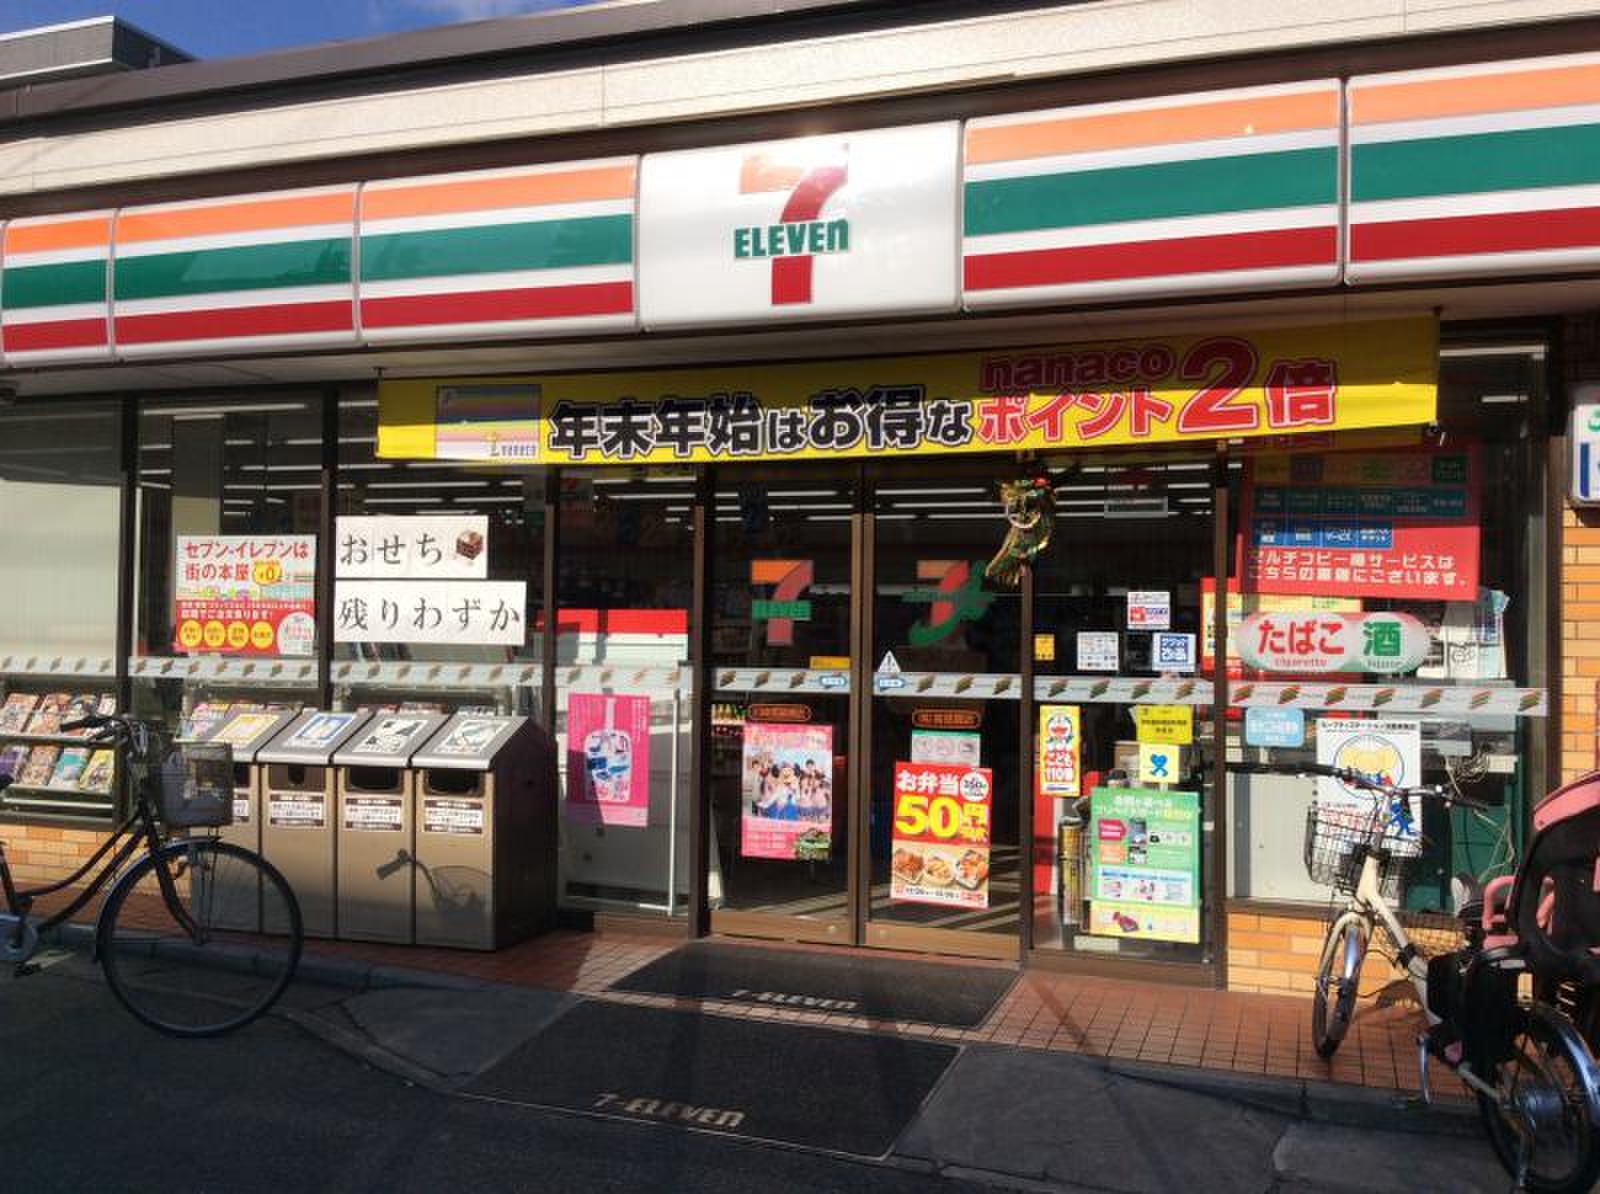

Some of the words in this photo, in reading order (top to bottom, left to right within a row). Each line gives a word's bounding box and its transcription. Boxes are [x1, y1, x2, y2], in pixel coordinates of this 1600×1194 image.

[737, 143, 849, 306] 7
[980, 344, 1177, 392] nanaco
[341, 533, 442, 565] おせち
[339, 597, 520, 631] 残りわずか
[1257, 619, 1345, 656] たばこ
[1362, 621, 1402, 657] 酒
[897, 770, 960, 796] お弁当
